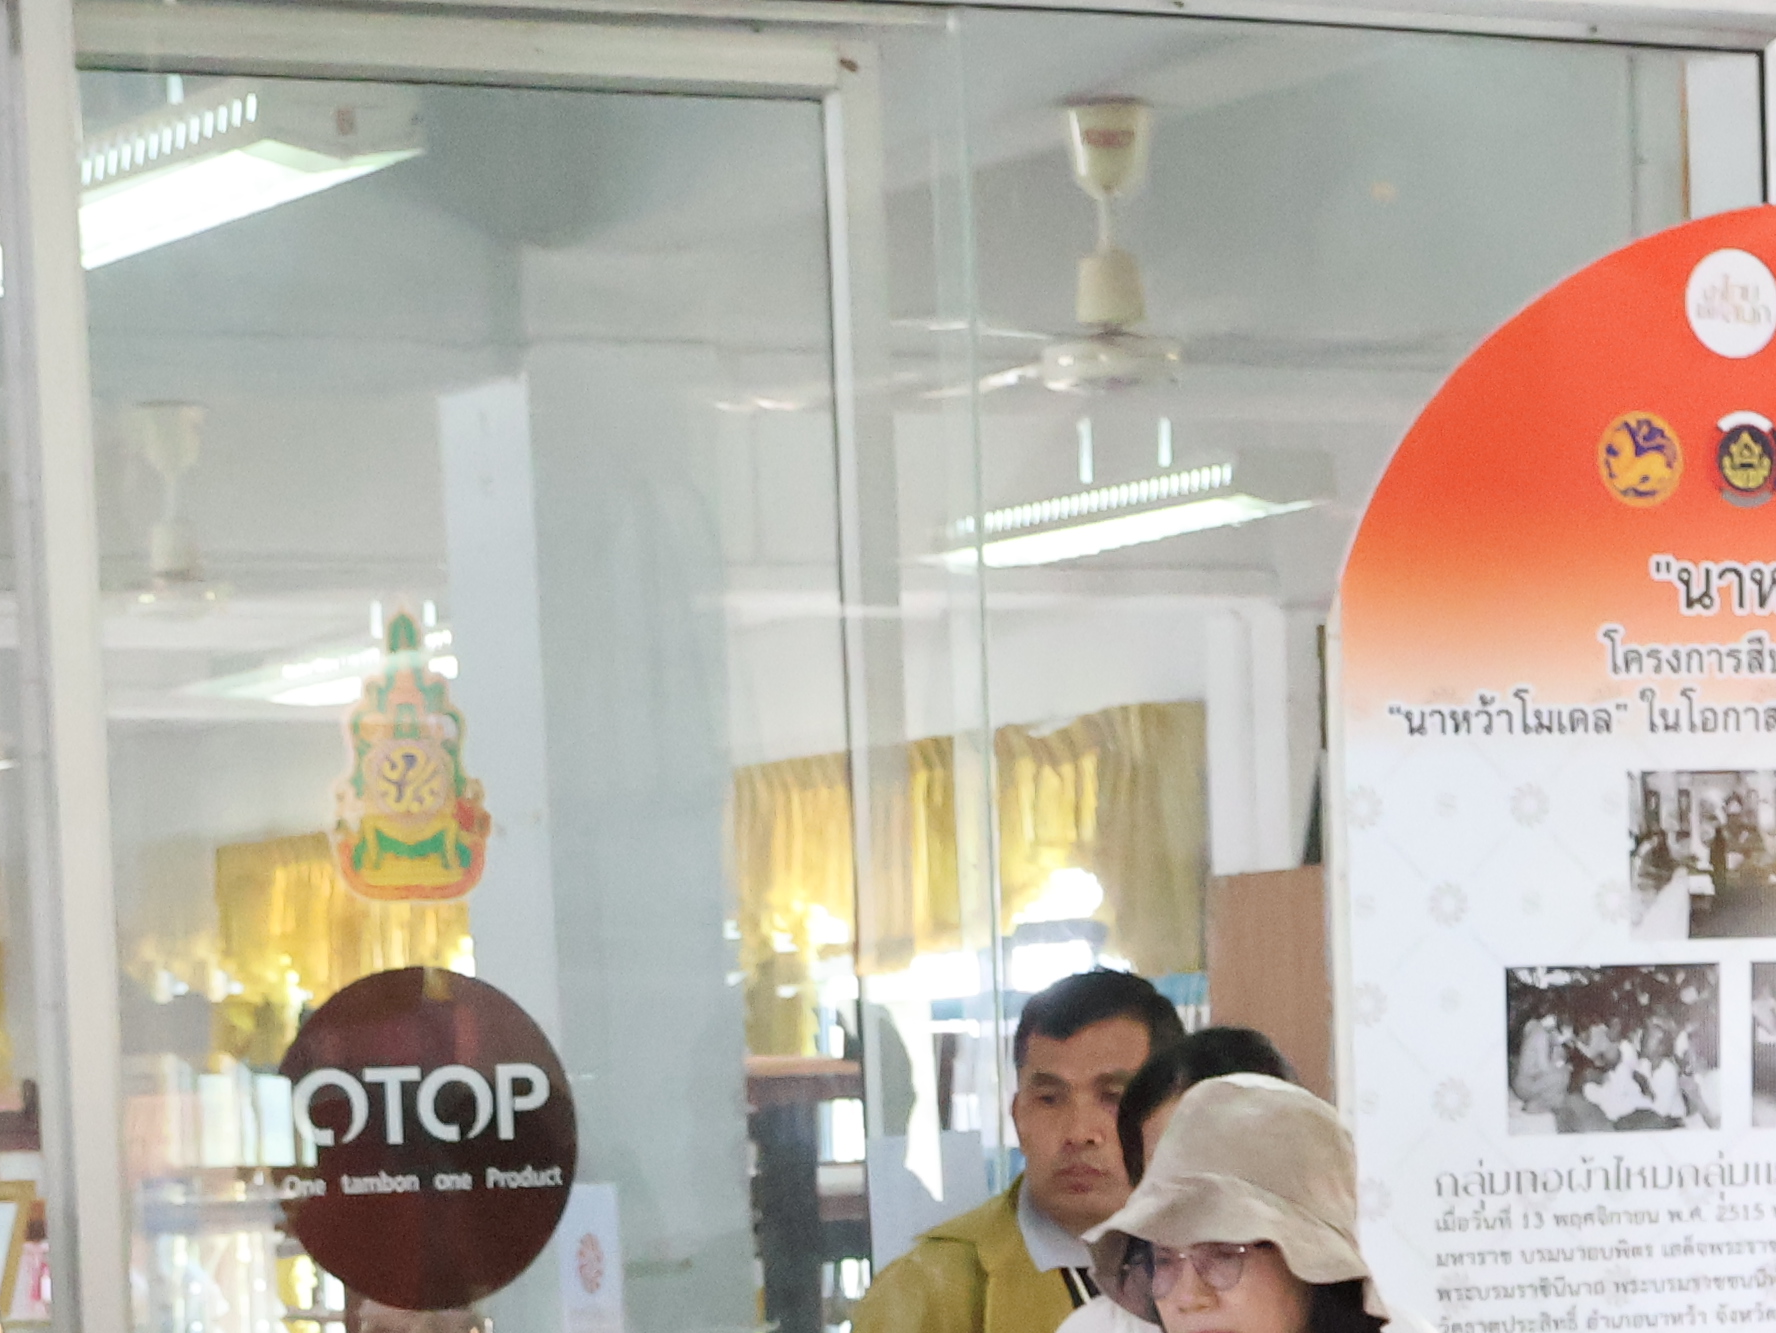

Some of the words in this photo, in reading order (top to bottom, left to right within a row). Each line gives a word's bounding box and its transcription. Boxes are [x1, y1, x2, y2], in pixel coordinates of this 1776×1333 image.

[292, 1062, 552, 1148] OTOP
[341, 1170, 420, 1196] tambon
[433, 1173, 474, 1192] one
[485, 1164, 564, 1189] Product
